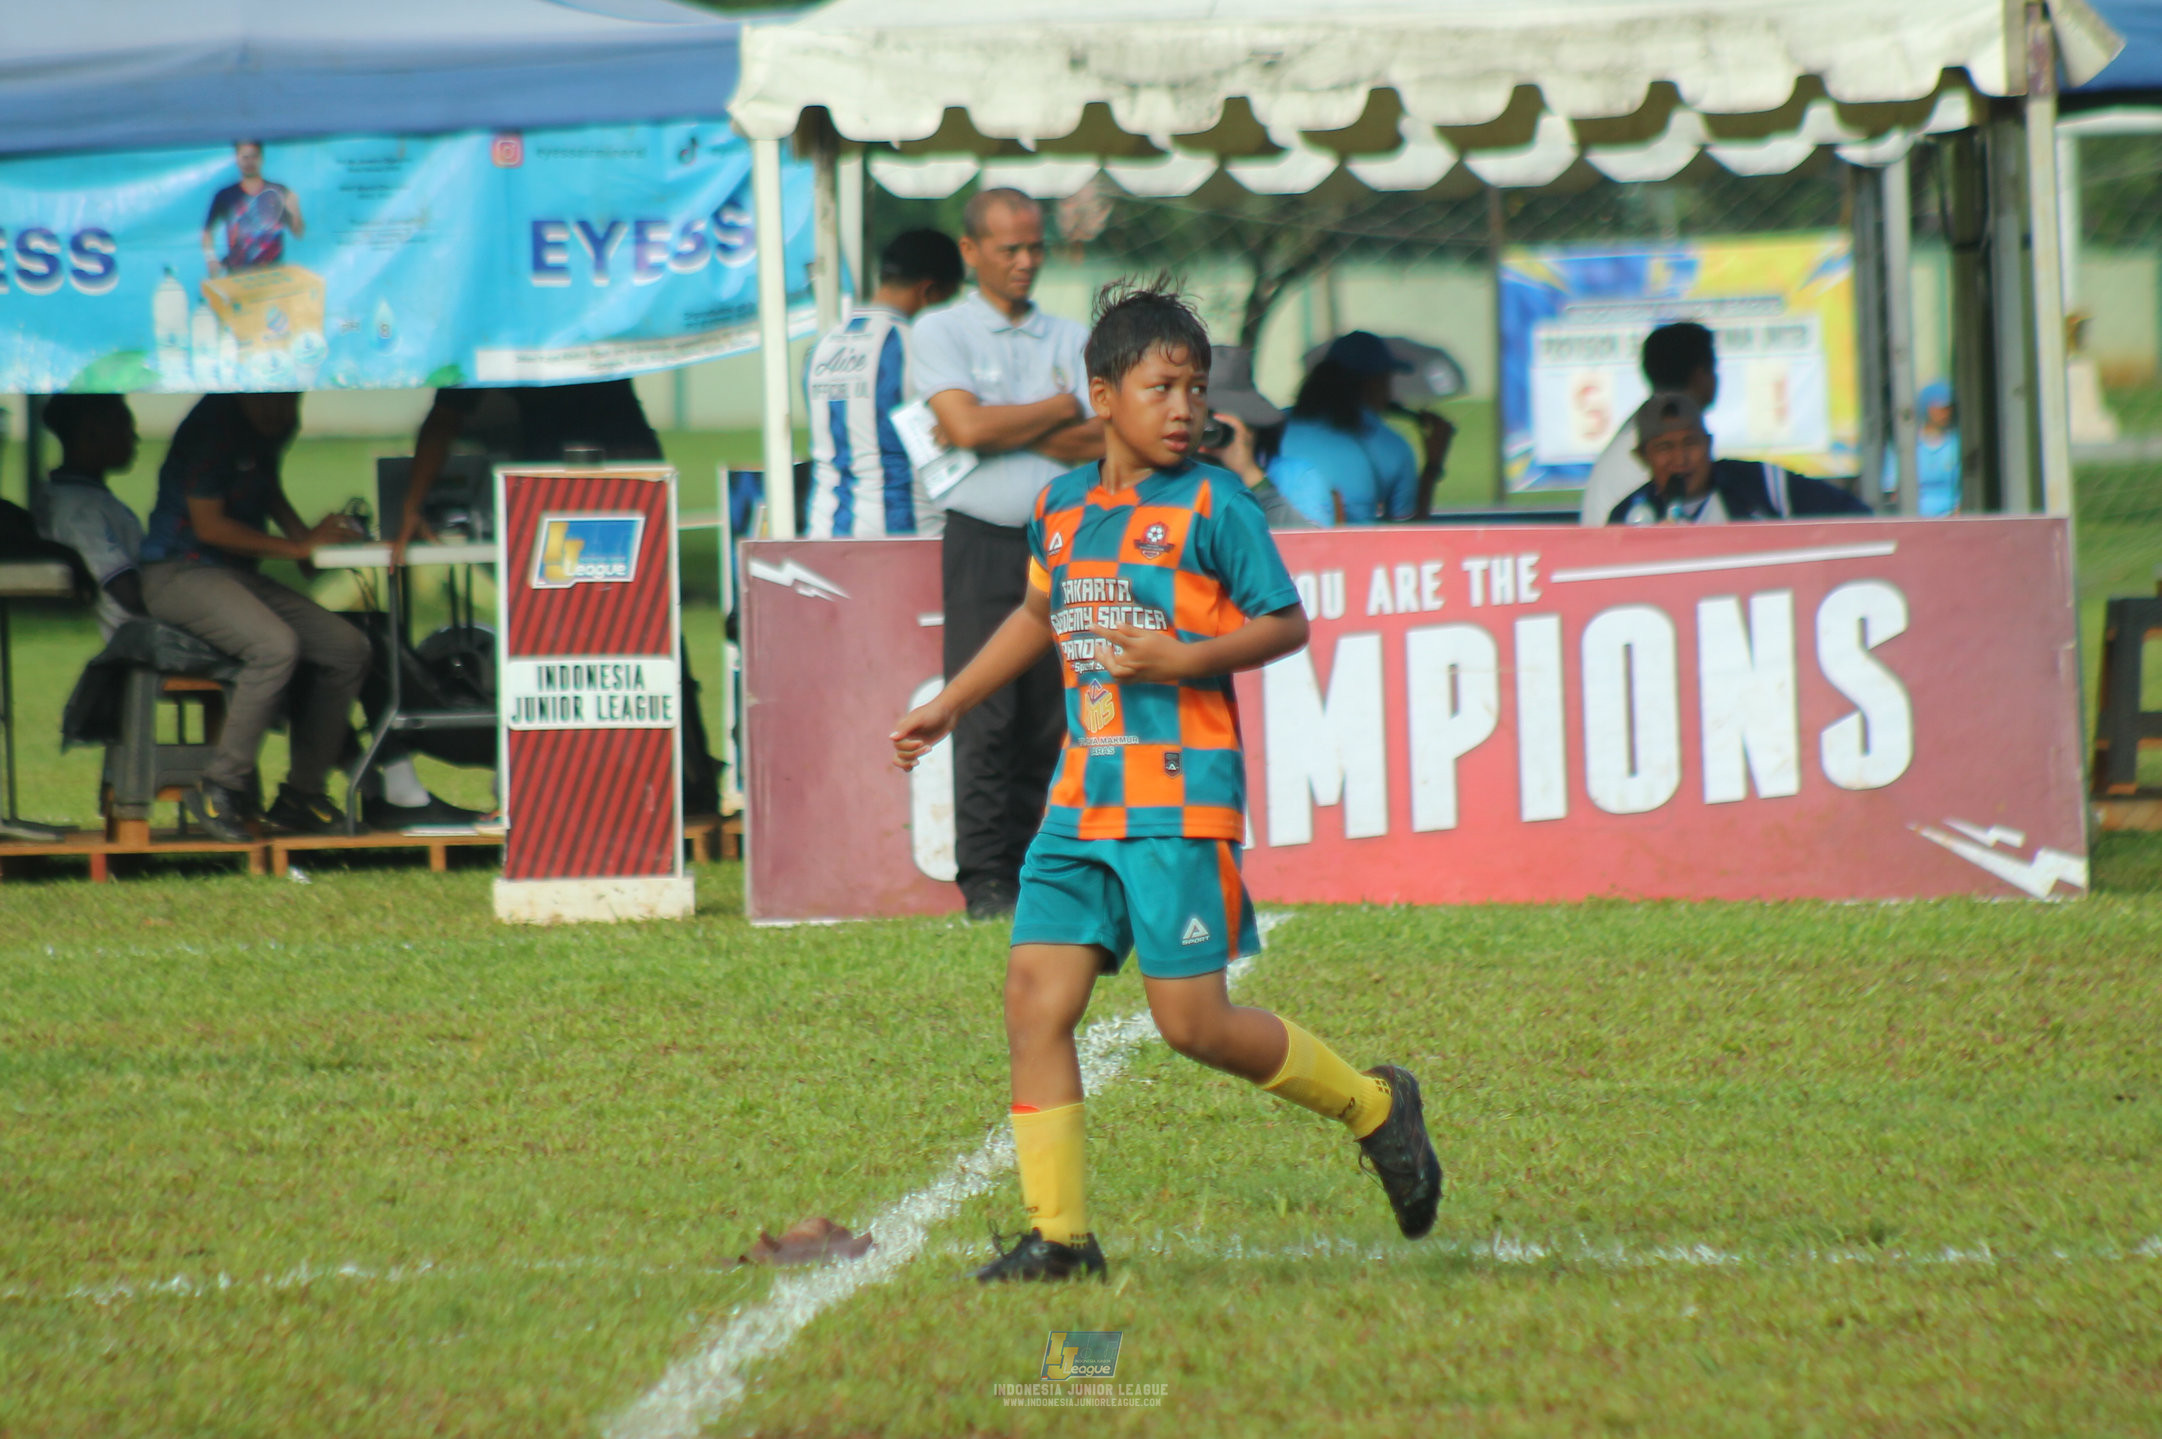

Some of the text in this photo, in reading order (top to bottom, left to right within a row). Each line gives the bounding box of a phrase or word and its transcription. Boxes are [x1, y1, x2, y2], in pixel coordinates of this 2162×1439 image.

[0, 226, 119, 296] SS
[531, 198, 757, 287] EYESS
[1292, 552, 1542, 623] OU ARE THE
[511, 694, 674, 724] JUNIOR LEAGUE
[538, 664, 644, 691] INDONESIA
